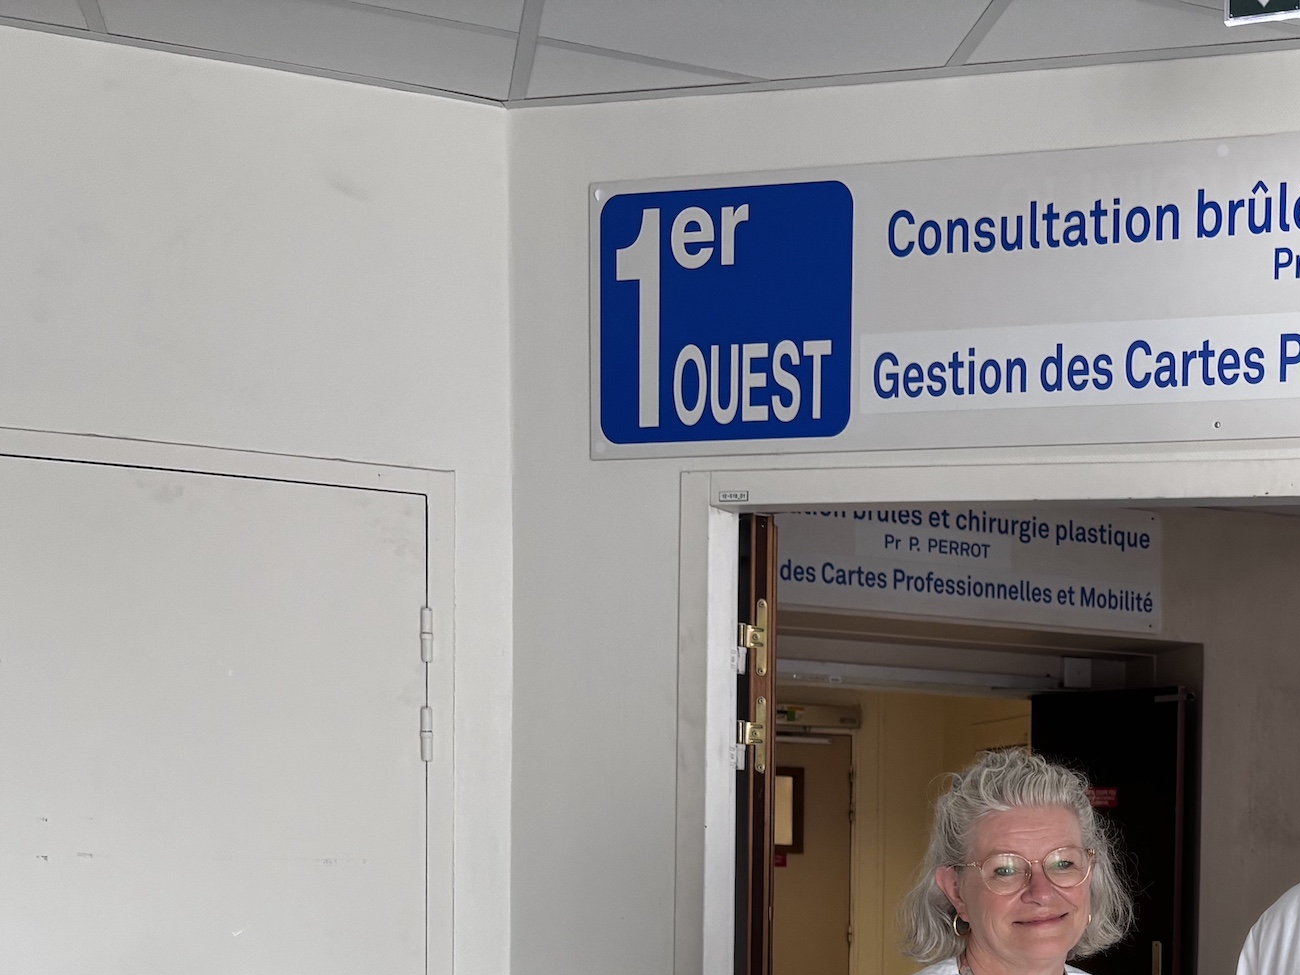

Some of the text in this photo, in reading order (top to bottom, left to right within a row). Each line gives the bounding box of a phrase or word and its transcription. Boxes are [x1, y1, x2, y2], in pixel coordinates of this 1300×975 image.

[888, 199, 1180, 258] Consultation
[616, 203, 750, 428] 1er
[673, 340, 832, 426] OUEST
[873, 347, 1028, 400] Gestion
[1040, 343, 1114, 393] des
[1125, 339, 1266, 390] Cartes
[884, 533, 992, 560] Pr P. PERROT
[927, 509, 951, 530] et
[955, 509, 1050, 545] chirurgie
[1055, 518, 1151, 553] plastique
[779, 559, 1154, 614] des Cartes Professionnelles et Mobilité
